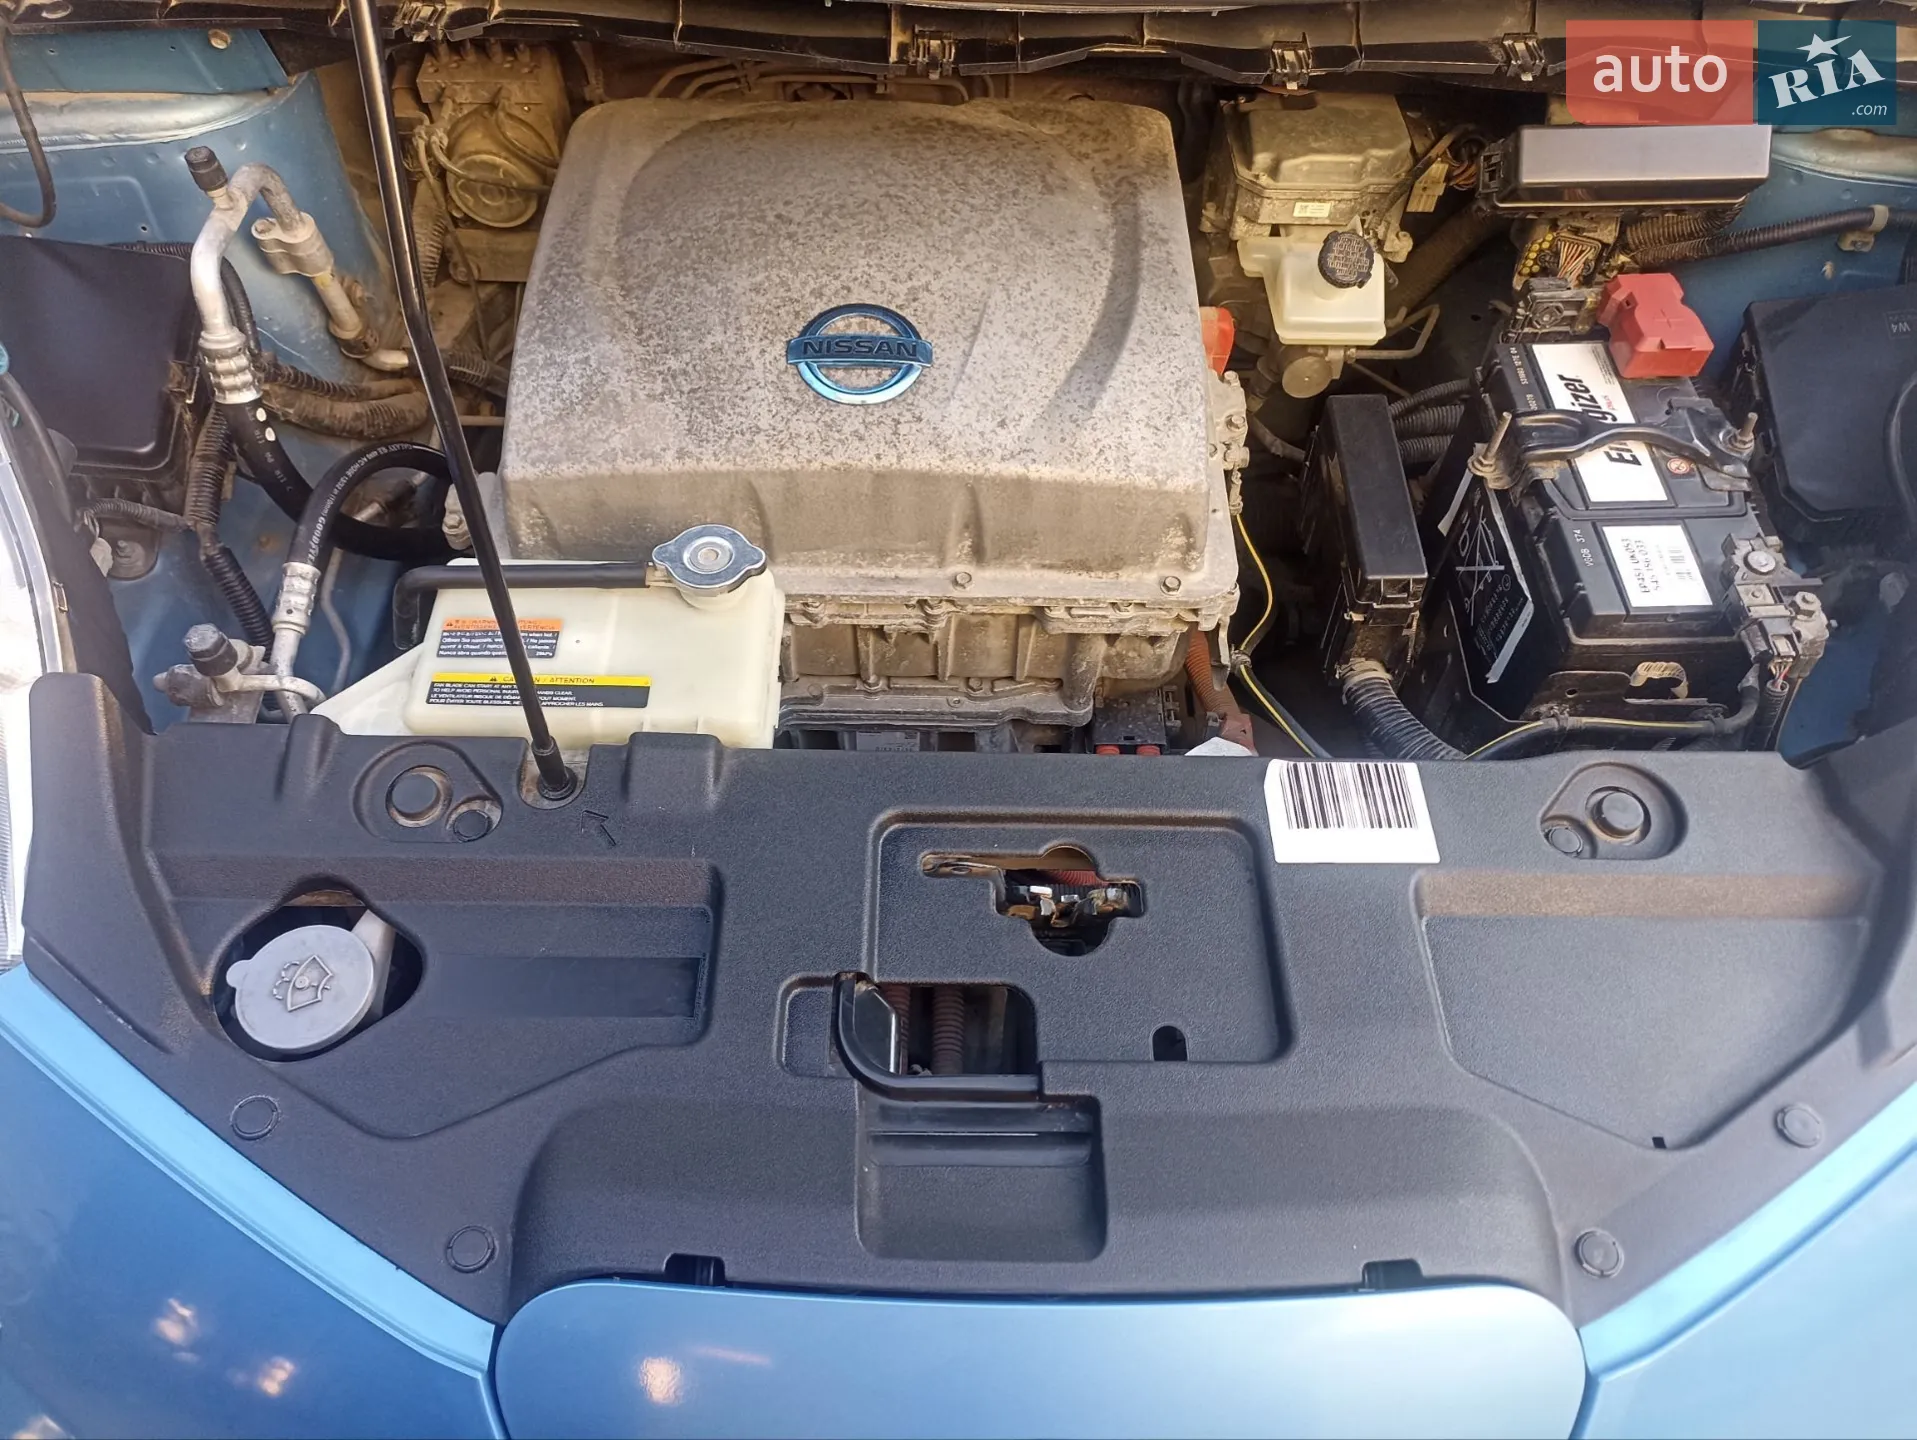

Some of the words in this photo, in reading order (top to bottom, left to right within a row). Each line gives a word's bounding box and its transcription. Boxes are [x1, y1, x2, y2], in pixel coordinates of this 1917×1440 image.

[802, 340, 918, 357] NISSAN
[1557, 373, 1642, 466] Engizer
[549, 676, 595, 684] ATTENTION
